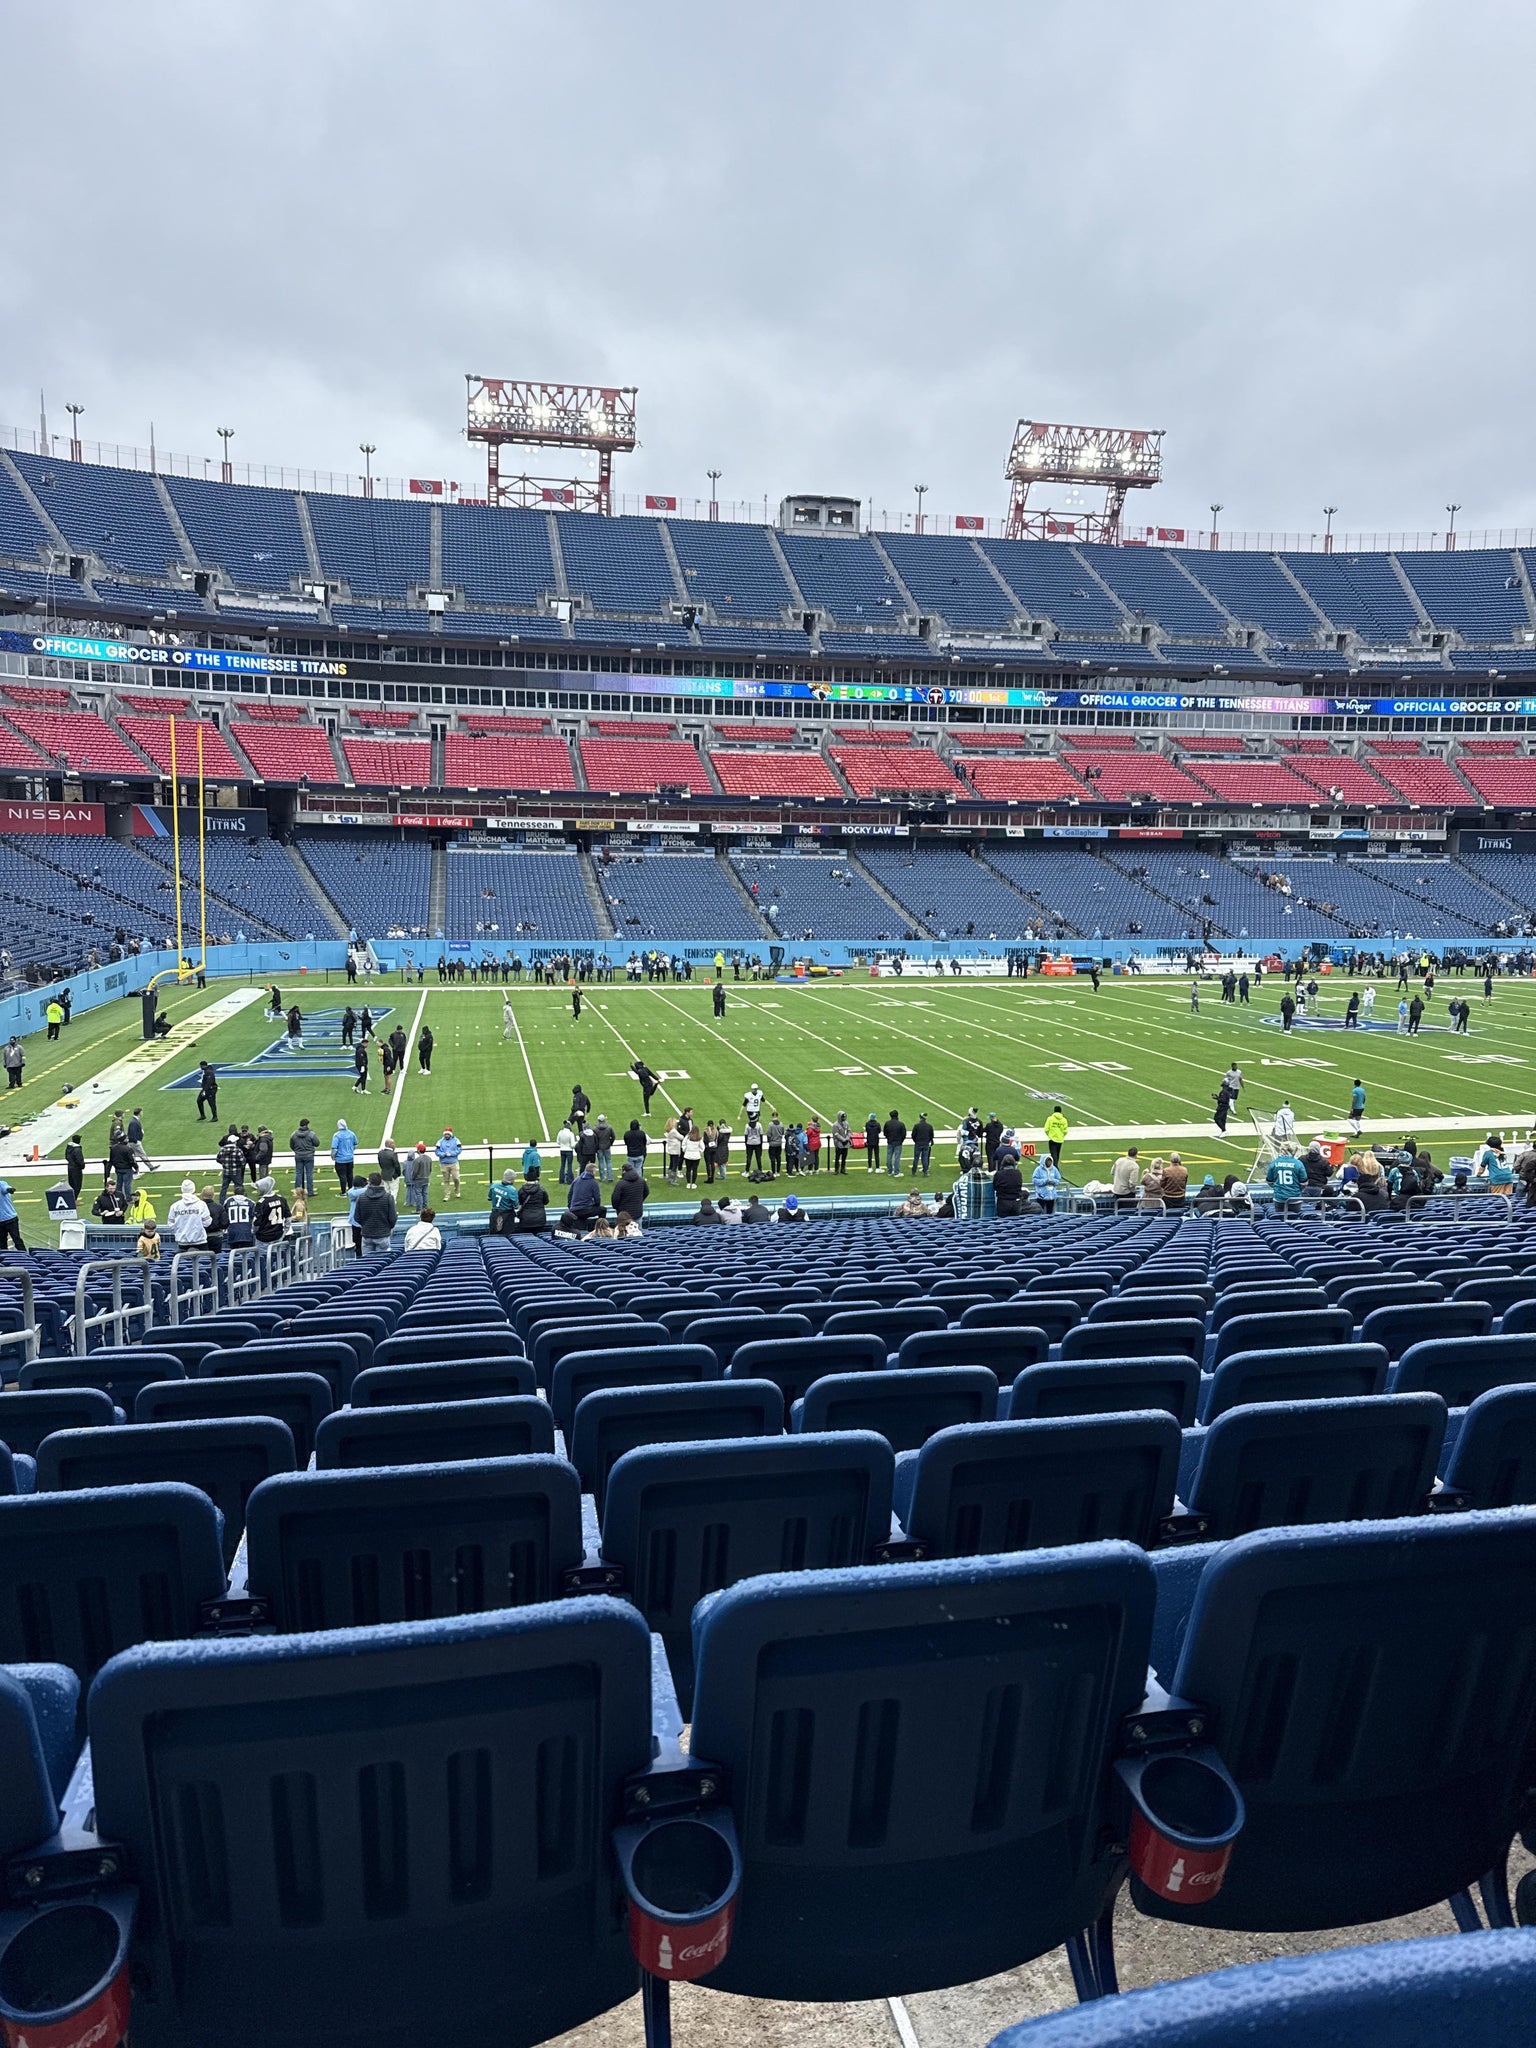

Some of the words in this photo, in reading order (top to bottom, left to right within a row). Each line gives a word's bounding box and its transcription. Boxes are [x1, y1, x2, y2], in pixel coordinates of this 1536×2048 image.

[32, 637, 102, 656] OFFICIAL
[106, 645, 168, 663] GROCER
[172, 650, 192, 664] OF
[195, 653, 220, 666] THE
[225, 655, 298, 672] TENNESSEE
[300, 661, 348, 675] TITANS
[854, 687, 864, 699] 0
[888, 688, 898, 700] 0
[950, 690, 982, 702] 90:00
[1033, 691, 1058, 707] Kroger
[1080, 694, 1129, 706] OFFICIAL
[1131, 695, 1177, 707] GROCER
[1180, 697, 1194, 708] OF
[1196, 697, 1216, 708] THE
[1218, 698, 1272, 710] TENNESSEE
[1275, 700, 1310, 711] TITANS
[1345, 699, 1372, 714] Kroger
[1393, 701, 1446, 712] OFFICIAL
[1449, 701, 1501, 712] GROCER
[1505, 701, 1522, 711] OF
[8, 808, 92, 821] NISSAN
[204, 816, 246, 831] TITANS
[494, 819, 558, 829] Tennessean.
[841, 826, 871, 834] ROCKY
[872, 826, 892, 834] LAW
[1064, 829, 1099, 837] Gallagher
[1477, 836, 1513, 849] TITANS
[1024, 1145, 1035, 1156] 20
[1319, 1145, 1332, 1158] G
[1277, 1169, 1294, 1185] 16
[55, 1196, 69, 1209] A
[495, 1194, 502, 1208] 7
[174, 1209, 200, 1217] PACKERS
[228, 1206, 250, 1224] 00
[268, 1206, 283, 1225] 41
